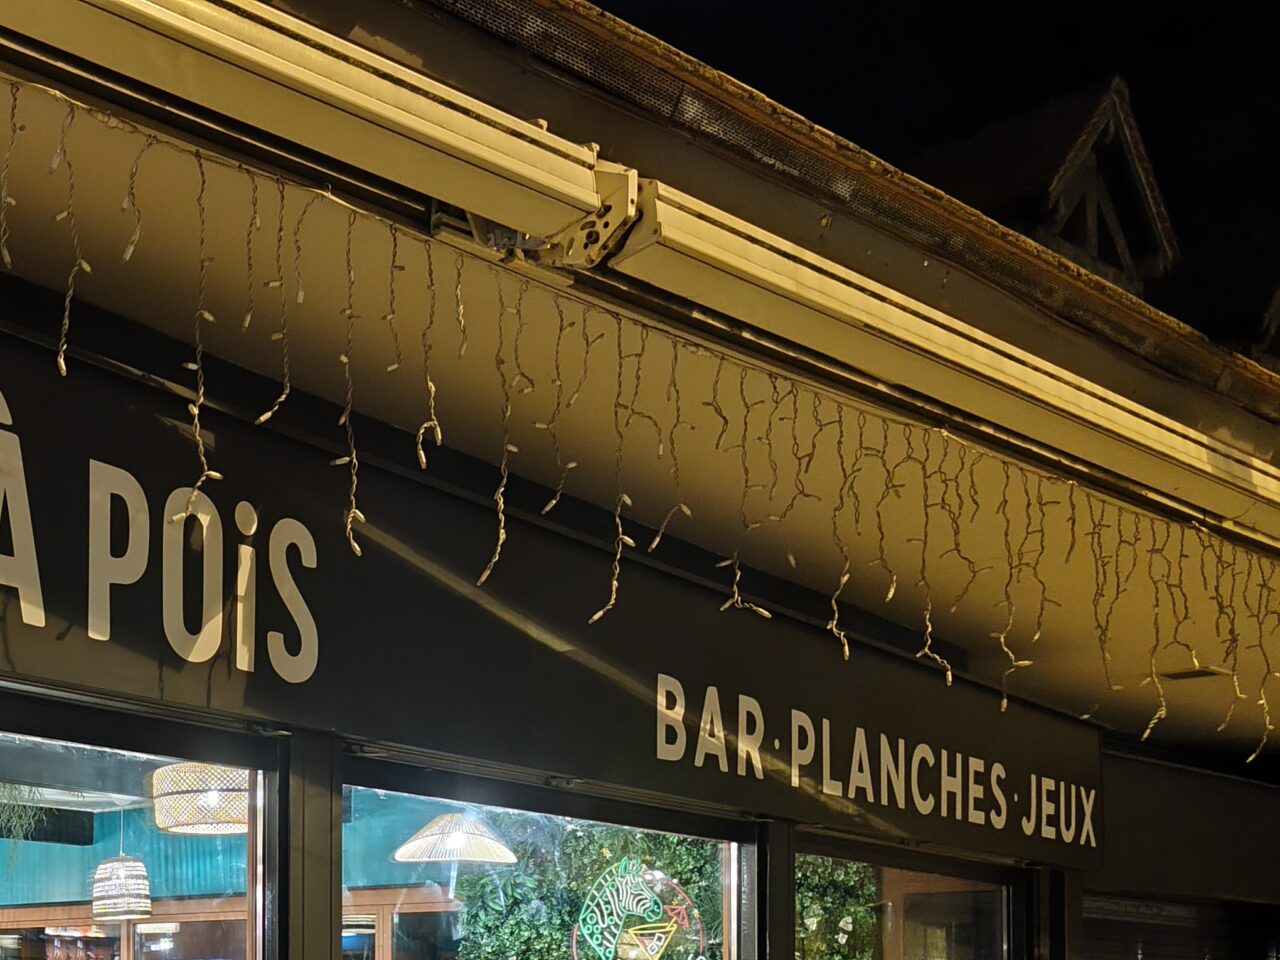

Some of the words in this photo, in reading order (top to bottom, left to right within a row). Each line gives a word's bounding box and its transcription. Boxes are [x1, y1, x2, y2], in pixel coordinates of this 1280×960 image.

[656, 672, 765, 780] BAR
[790, 708, 1007, 830] PLANCHES
[1021, 773, 1097, 848] JEUX
